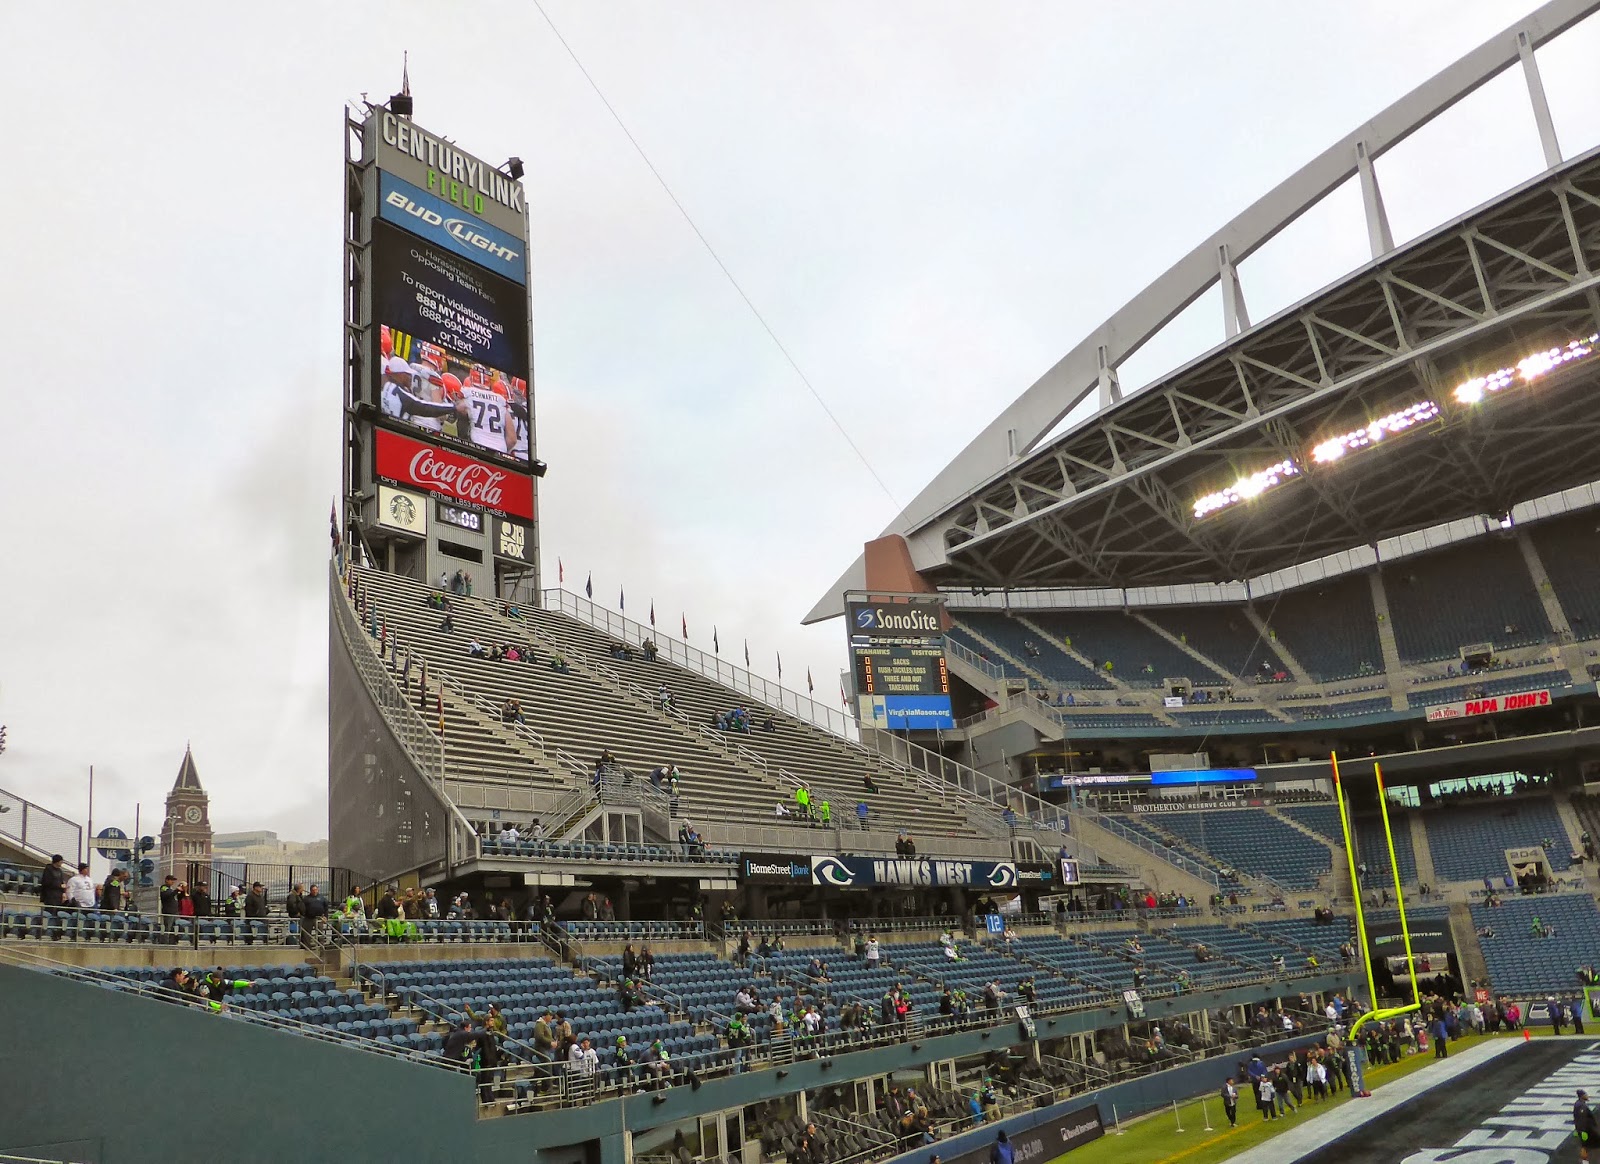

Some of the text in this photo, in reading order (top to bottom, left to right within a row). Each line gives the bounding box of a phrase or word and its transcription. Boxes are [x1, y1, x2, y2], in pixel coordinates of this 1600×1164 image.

[383, 112, 522, 213] CENTURYLINK
[427, 170, 484, 214] FIELD
[386, 191, 518, 261] BUD LIGHT
[410, 248, 454, 281] Opposing
[455, 275, 478, 294] Team
[401, 270, 503, 334] To report violations call
[416, 292, 492, 339] 888 MY HAWKS
[419, 306, 491, 350] (888-694-2957)
[440, 331, 473, 353] or Text
[471, 391, 499, 402] SCHWARTZ
[473, 400, 502, 434] 72
[410, 448, 507, 506] Coca-Cola
[501, 540, 525, 559] FOX
[876, 609, 937, 630] SonoSite
[1465, 691, 1549, 716] PAPA JOHN'S
[1133, 803, 1185, 812] BROTHERTON
[106, 850, 117, 858] 145
[874, 860, 972, 885] HAWKS NEST
[430, 903, 438, 913] 51
[989, 916, 1001, 932] 12
